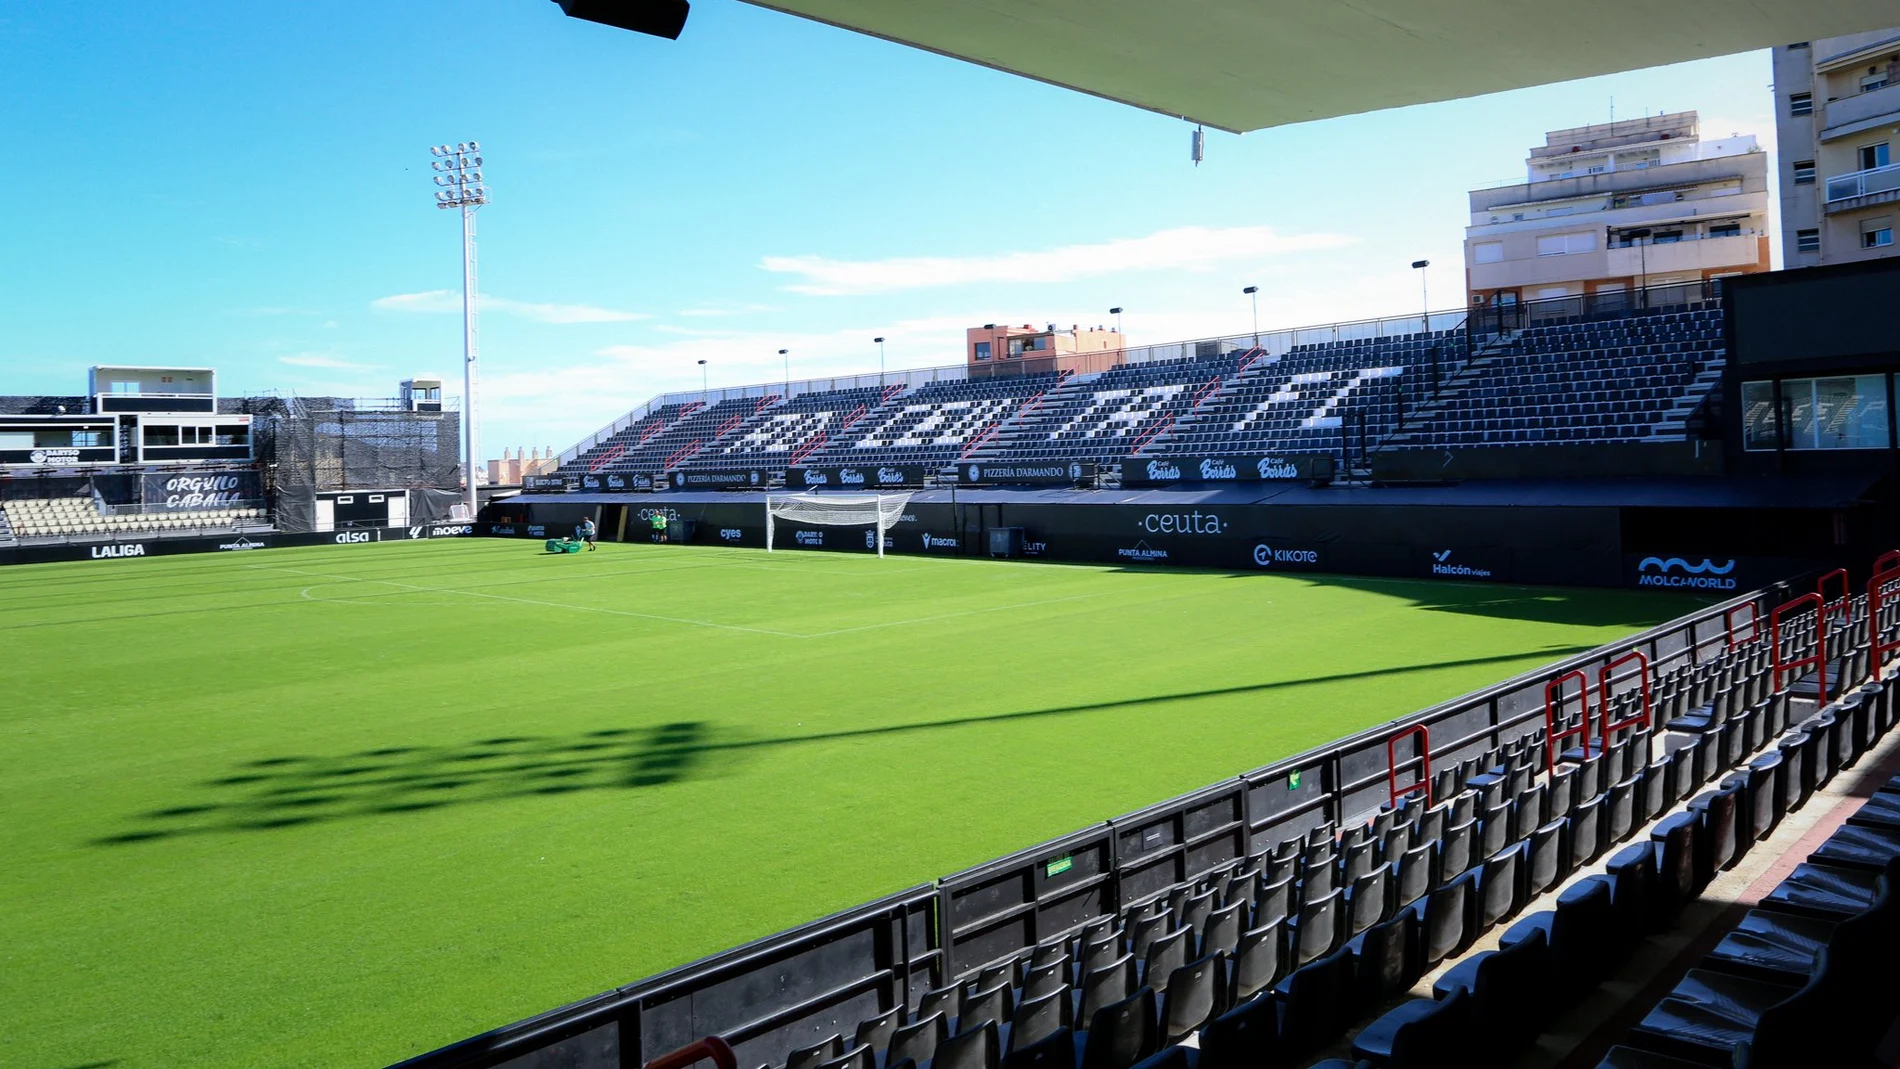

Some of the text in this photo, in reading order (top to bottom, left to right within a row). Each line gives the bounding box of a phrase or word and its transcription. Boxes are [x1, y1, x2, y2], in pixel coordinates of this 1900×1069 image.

[983, 466, 1014, 478] PIZZERÍA
[1145, 510, 1221, 534] ceuta
[432, 525, 472, 536] moeve
[720, 529, 742, 540] cyes
[335, 531, 369, 543] alsa
[91, 544, 145, 558] LALIGA
[1141, 550, 1168, 558] ALMINA
[1433, 563, 1491, 577] Halcón viajes
